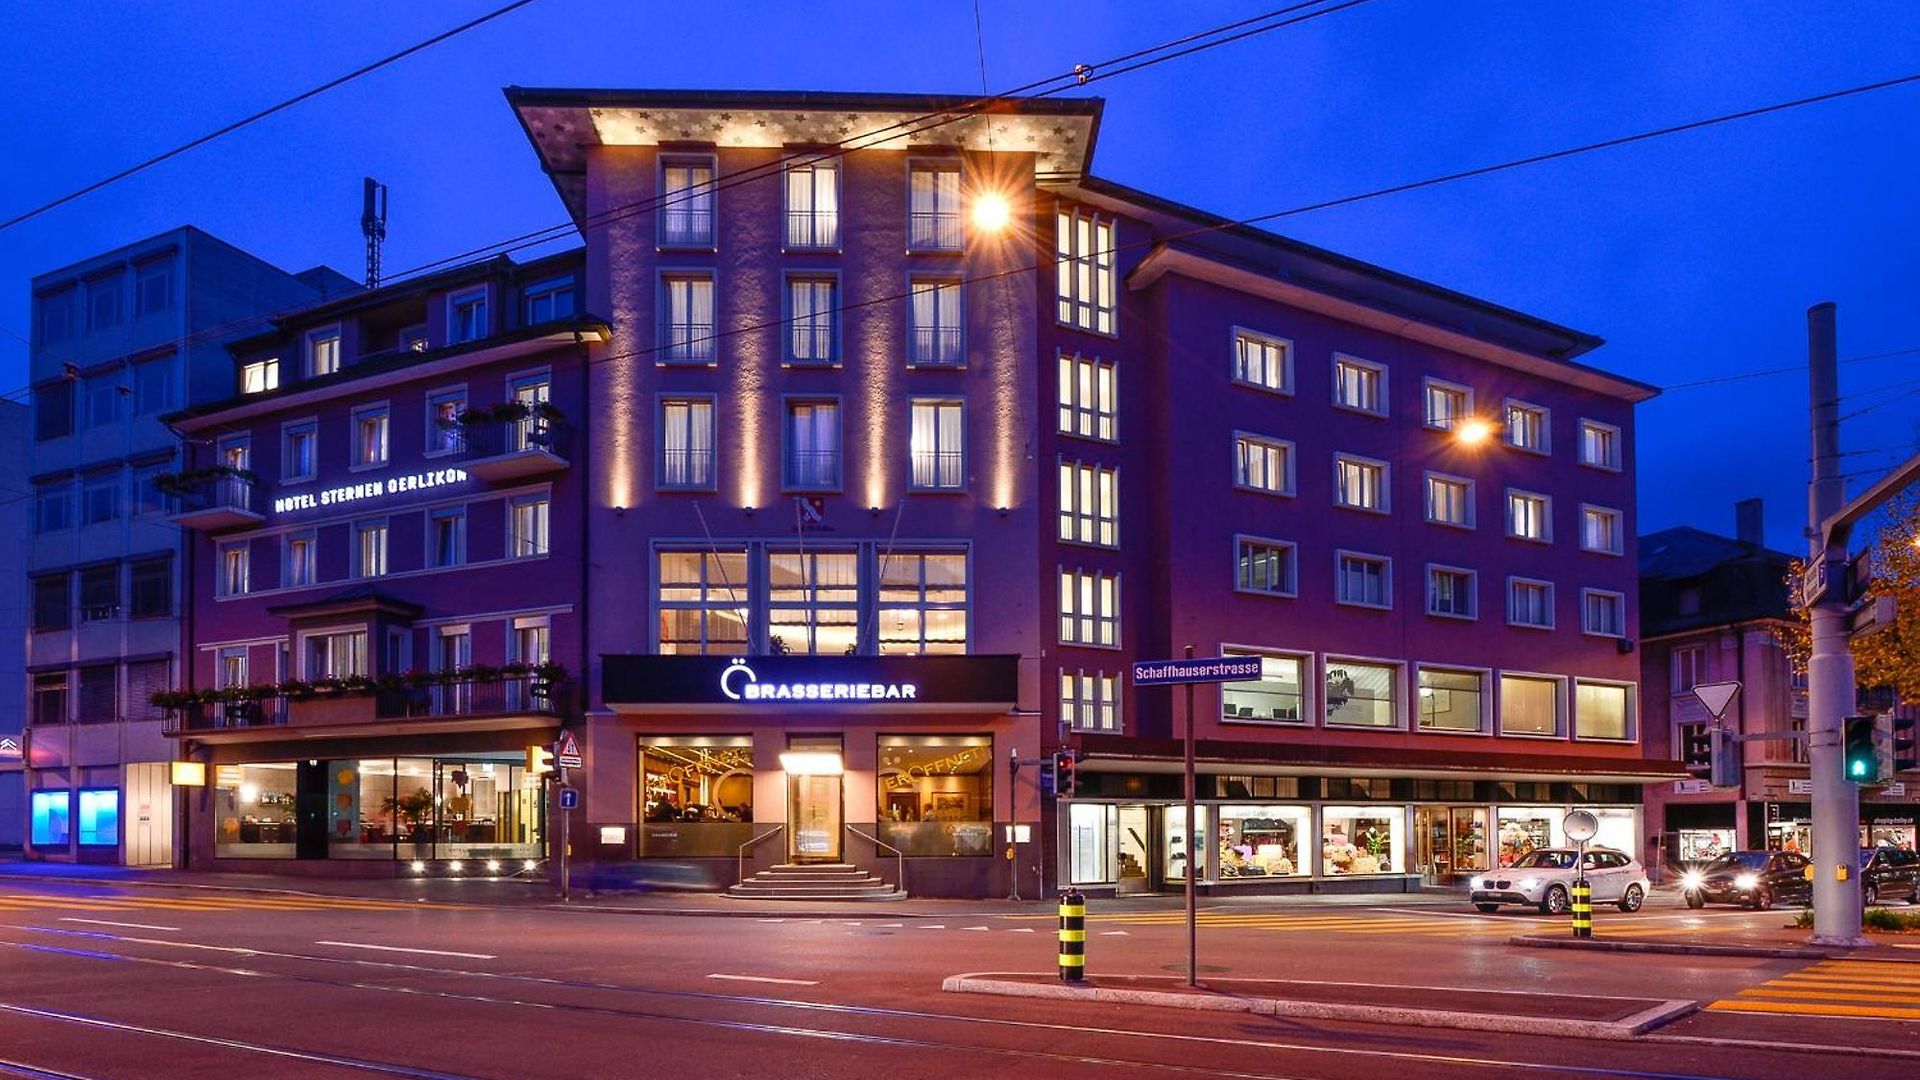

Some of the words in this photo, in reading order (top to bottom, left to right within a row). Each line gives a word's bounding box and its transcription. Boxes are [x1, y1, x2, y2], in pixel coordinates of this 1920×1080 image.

[275, 494, 317, 513] HOTEL
[321, 482, 383, 505] STERNEN
[387, 468, 467, 493] OERLIKON
[1136, 663, 1258, 679] Schaffhauserstrasse
[744, 684, 916, 700] BRASSERIEBAR
